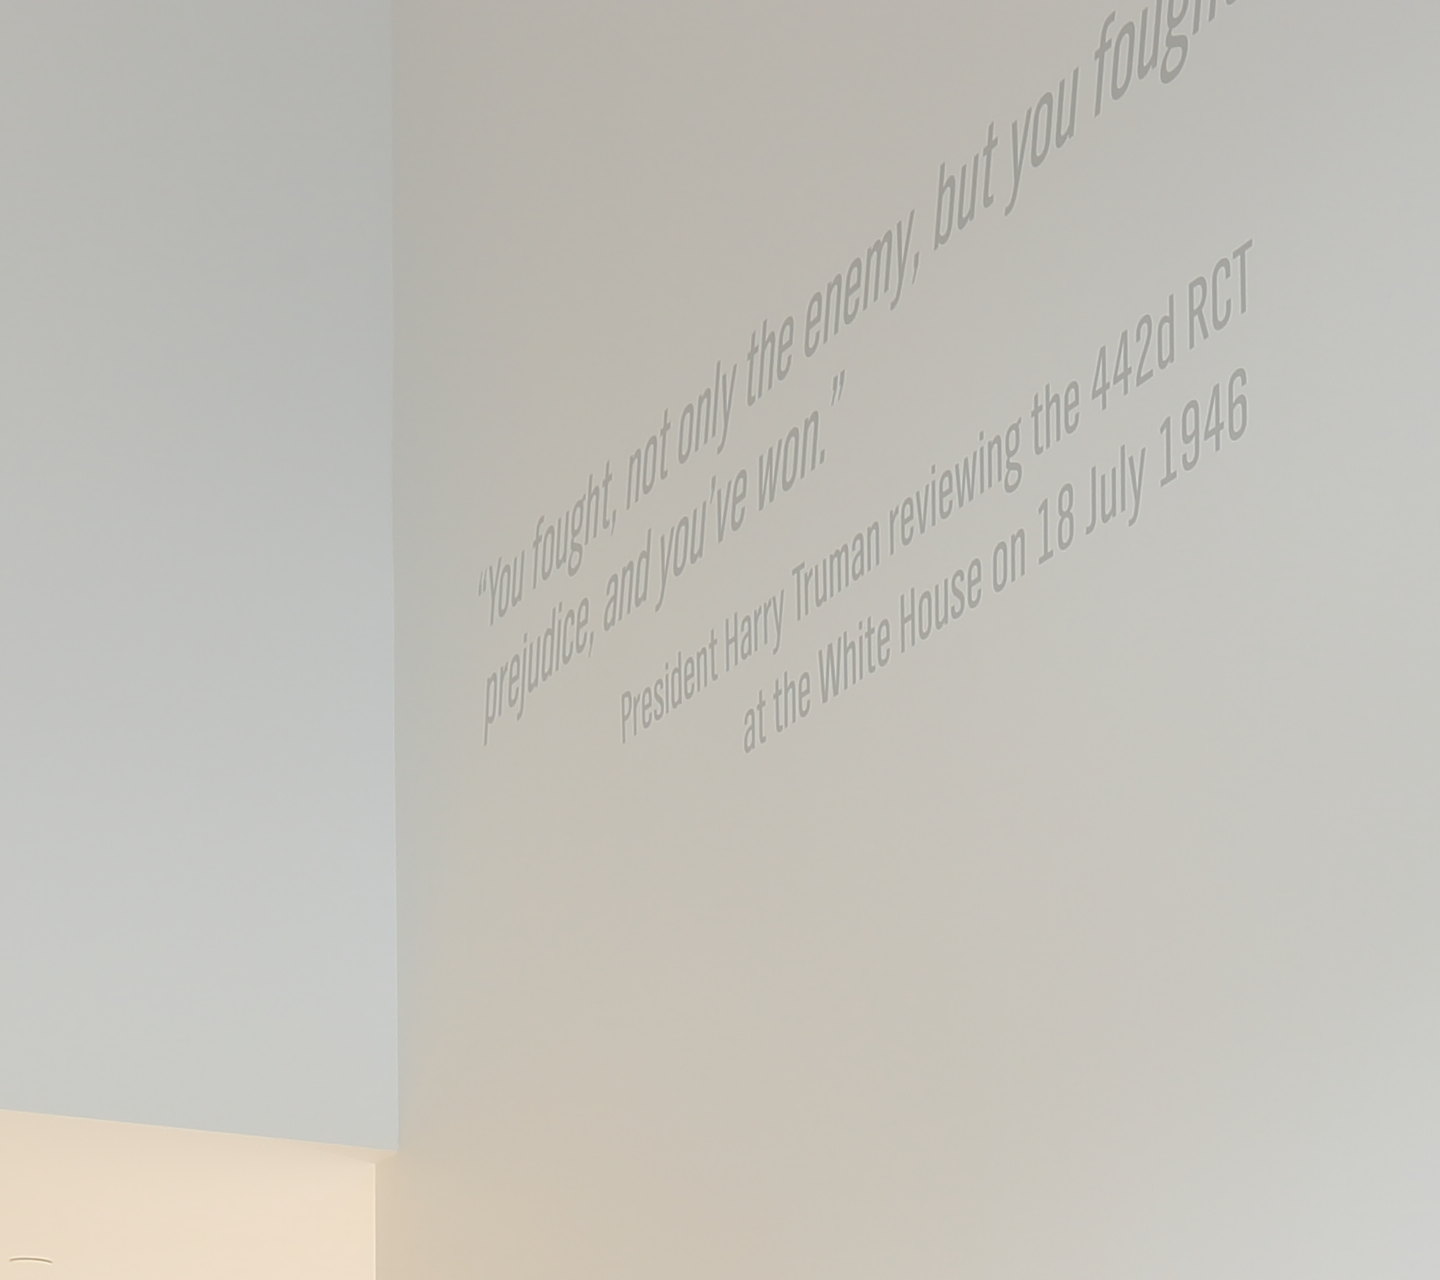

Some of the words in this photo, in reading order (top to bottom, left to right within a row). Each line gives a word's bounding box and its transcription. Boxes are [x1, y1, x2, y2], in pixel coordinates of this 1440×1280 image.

[533, 461, 616, 589] fought,
[627, 409, 670, 510] not
[678, 361, 737, 464] only
[747, 316, 794, 406] the
[805, 210, 919, 357] enemy,
[934, 122, 998, 250] but
[1005, 67, 1079, 216] you
[1094, 0, 1235, 117] foug
[622, 629, 718, 743] President
[726, 590, 784, 671] Harry
[792, 522, 879, 621] Truman
[890, 417, 1022, 555] reviewing
[1031, 381, 1079, 455] the
[1092, 294, 1174, 410] 442d
[1189, 239, 1252, 349] RCT
[484, 598, 594, 745] prejudice,
[604, 529, 651, 631] and
[744, 690, 766, 753] at
[773, 672, 810, 732] the
[819, 617, 890, 703] White
[901, 558, 981, 653] House
[993, 529, 1025, 592] on
[1038, 483, 1074, 564] 18
[1086, 445, 1145, 535] July
[1160, 368, 1247, 487] 1946
